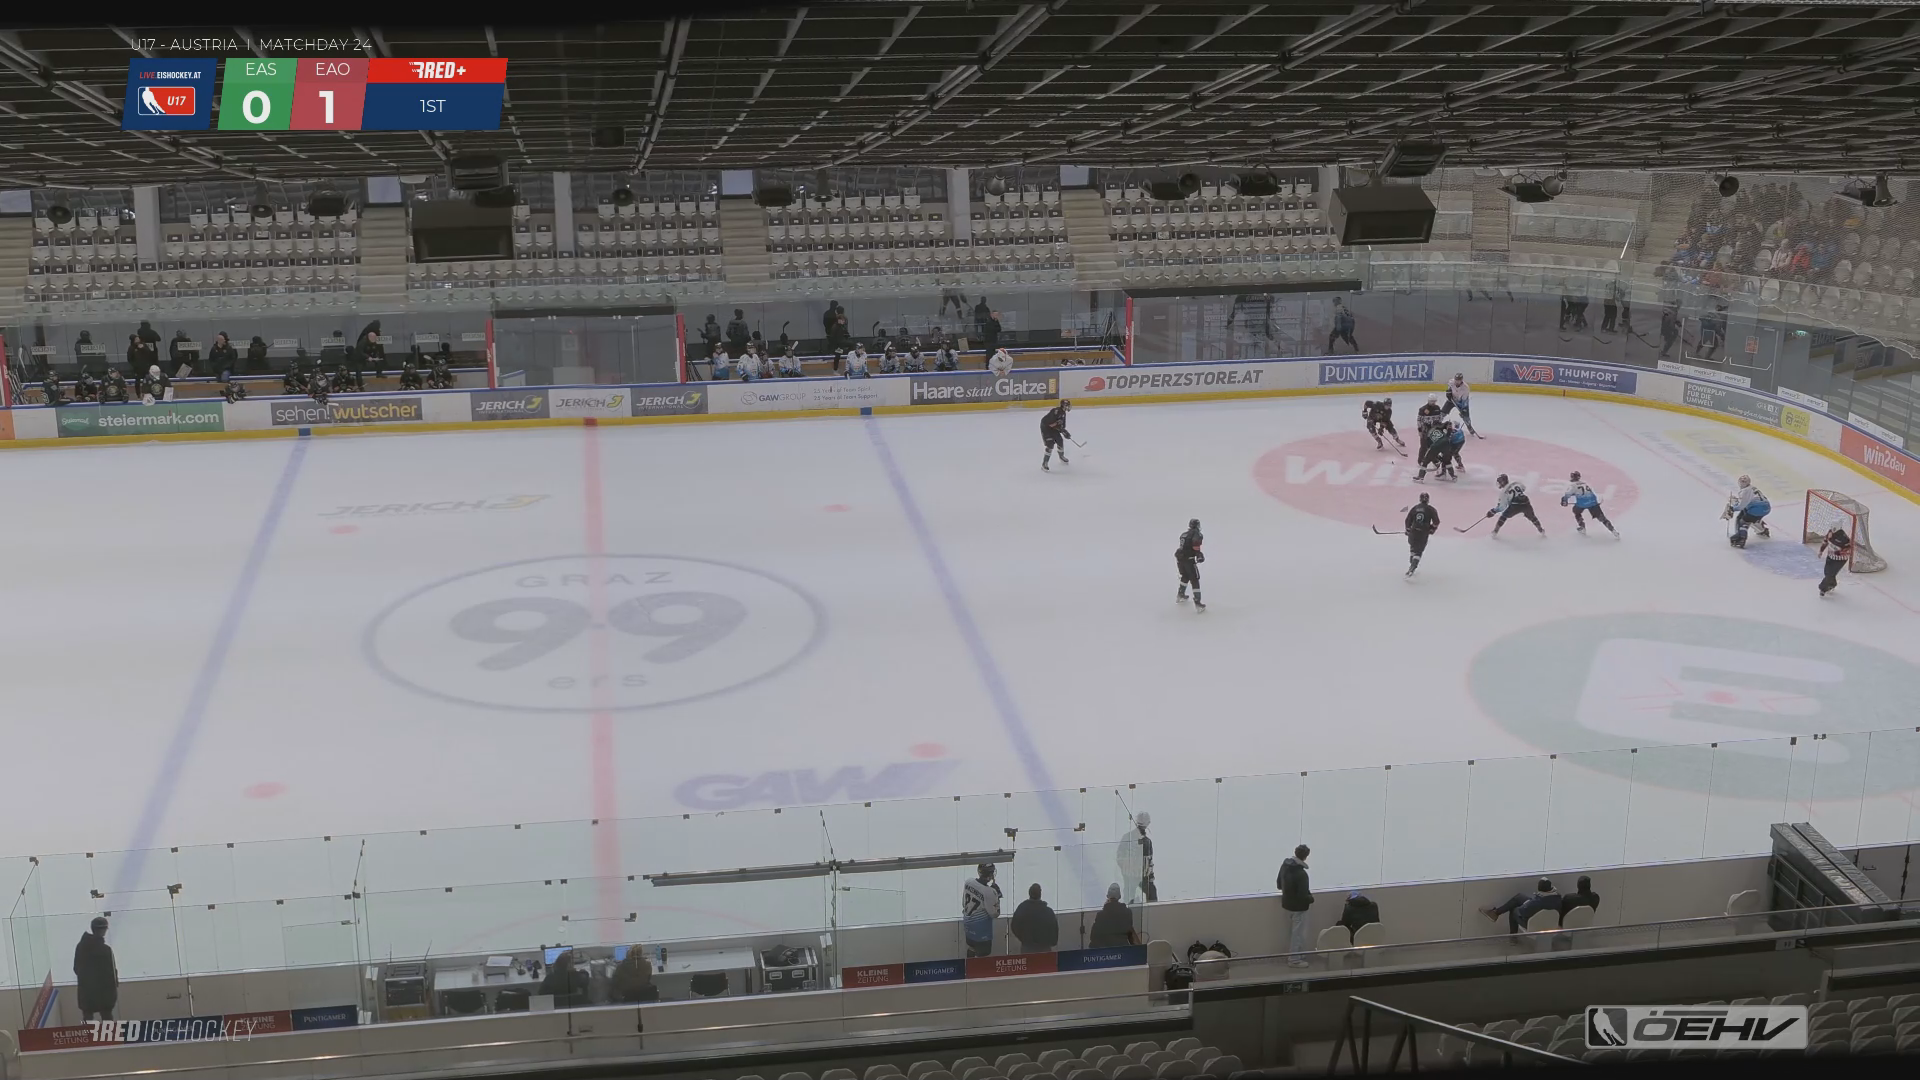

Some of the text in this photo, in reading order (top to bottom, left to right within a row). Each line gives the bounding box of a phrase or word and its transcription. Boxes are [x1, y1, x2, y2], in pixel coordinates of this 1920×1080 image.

[1325, 363, 1428, 382] PUNTIGAMER
[1558, 368, 1619, 382] THUMFORT
[1106, 370, 1263, 390] TOPPERZSTORE.AT
[913, 382, 964, 399] Haare
[966, 385, 993, 398] statt
[995, 378, 1047, 396] Glatze
[1687, 384, 1726, 397] POWERPLAY
[476, 401, 526, 411] JERICH
[556, 397, 606, 408] JERICH
[636, 396, 685, 407] JERICH
[1686, 396, 1713, 406] UMWELT
[333, 403, 418, 420] wutscher
[98, 412, 220, 427] steiermark.com
[317, 499, 487, 517] JERICH
[514, 571, 674, 588] GRAZ
[996, 958, 1027, 966] KLEINE
[1083, 954, 1122, 963] PUNTIGAMER
[857, 969, 889, 977] KLEINE
[915, 967, 955, 976] PUNTIGAMER
[996, 965, 1027, 973] ZEITUNG
[858, 976, 889, 984] ZEITUNG
[303, 1013, 346, 1023] PUNTIGAMER
[53, 1036, 89, 1045] ZEITUNG
